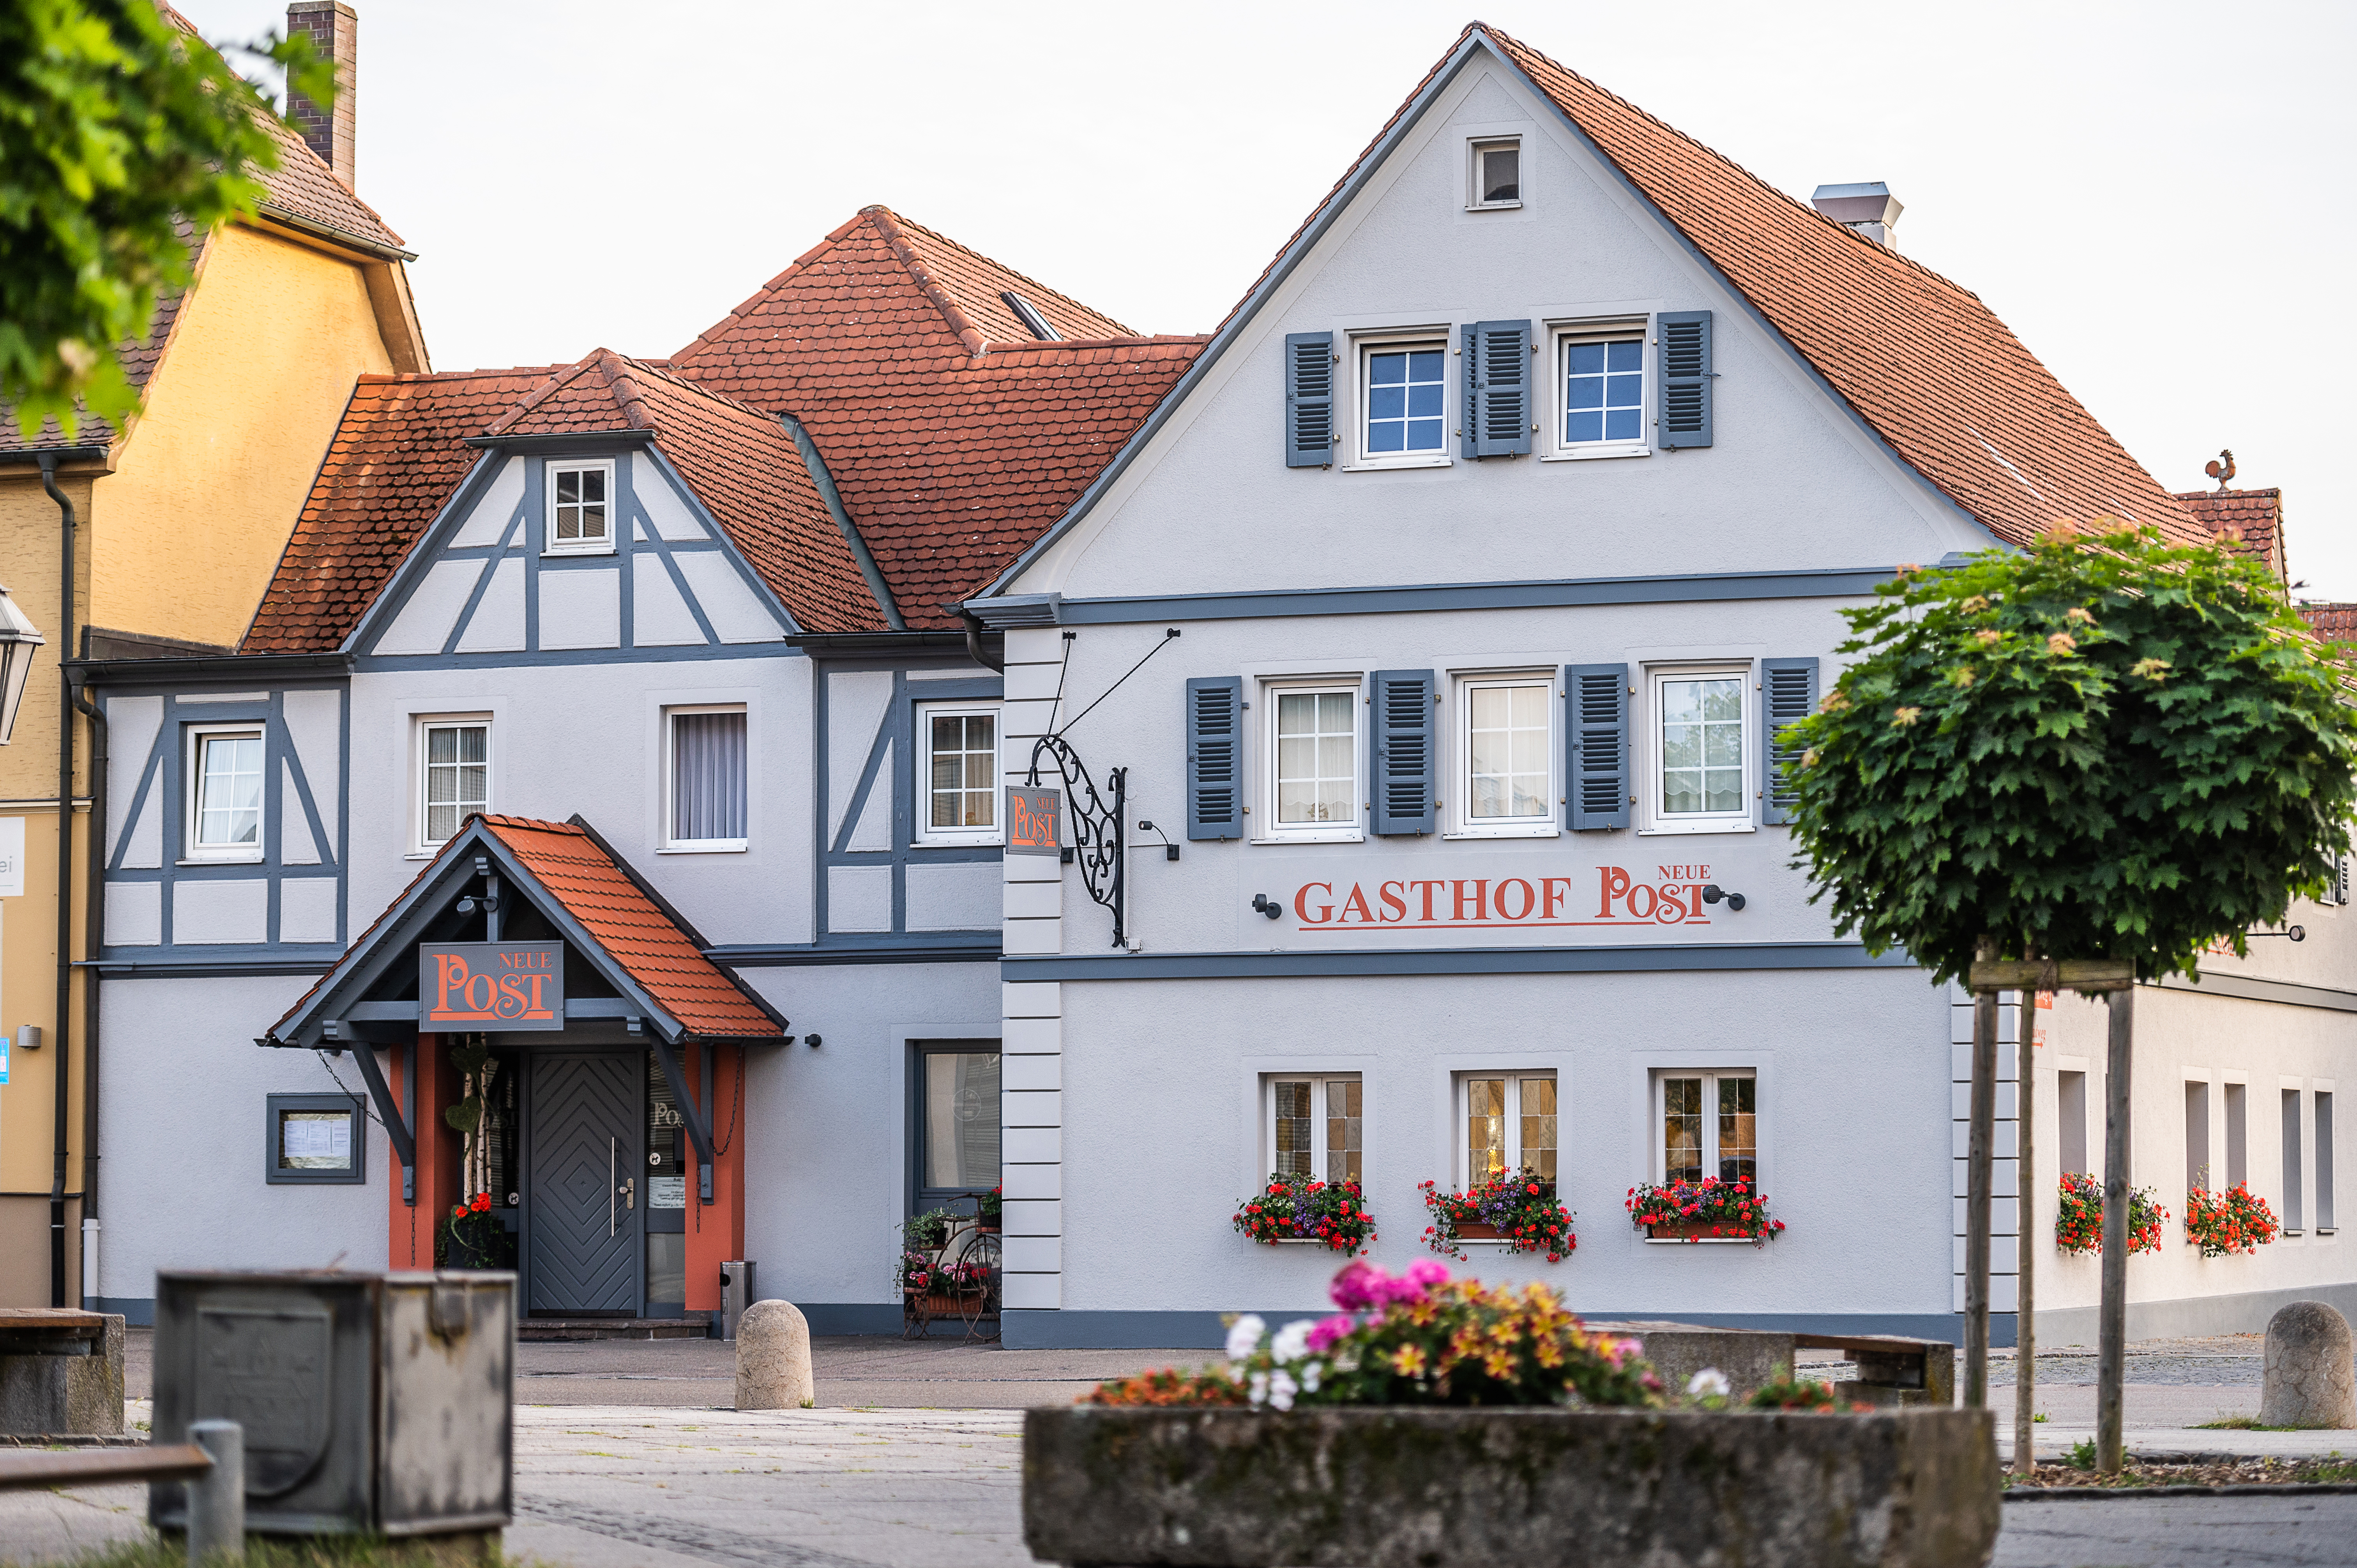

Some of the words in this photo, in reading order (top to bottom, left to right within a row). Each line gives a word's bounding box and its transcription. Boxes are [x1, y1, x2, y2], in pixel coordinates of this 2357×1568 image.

[1037, 797, 1056, 810] NEUE
[1658, 865, 1711, 879] NEUE
[1294, 878, 1571, 924] GASTHOF
[498, 951, 552, 969] NEUE
[2032, 1024, 2046, 1044] adweg
